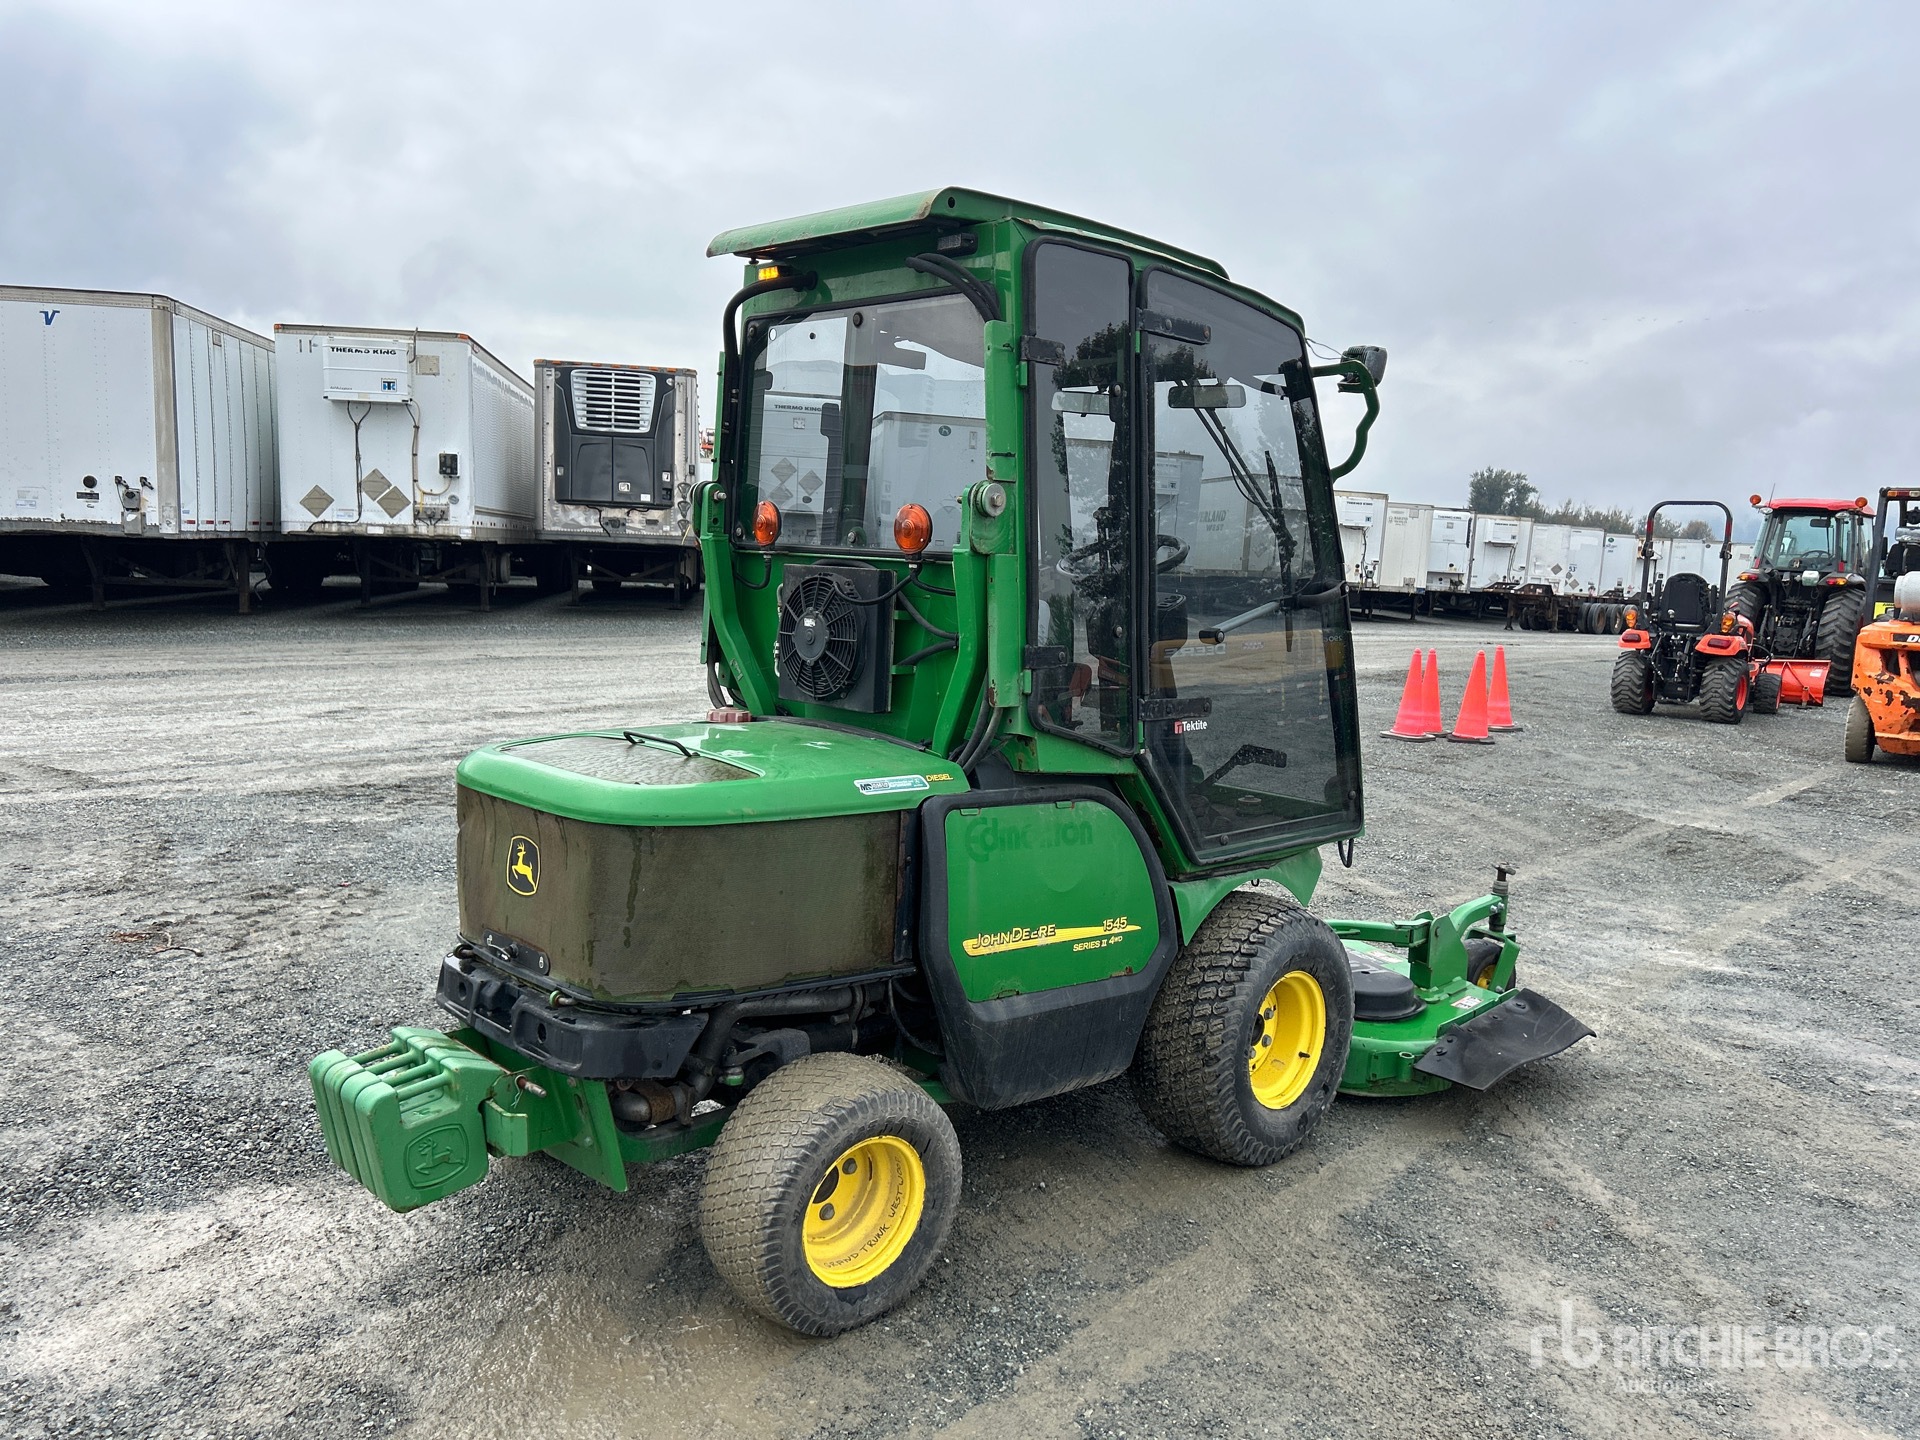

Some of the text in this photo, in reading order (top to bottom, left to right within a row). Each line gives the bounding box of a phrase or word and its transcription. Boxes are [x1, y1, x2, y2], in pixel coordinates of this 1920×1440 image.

[330, 346, 371, 355] THERMO
[1906, 634, 1920, 643] D
[1182, 720, 1208, 732] Tektite
[926, 773, 954, 782] DIESEL
[1102, 916, 1128, 932] 1545
[972, 929, 1012, 949] JOHN
[1072, 942, 1101, 952] SERIES
[823, 1252, 859, 1268] GRAND
[860, 1223, 890, 1253] TRUNK
